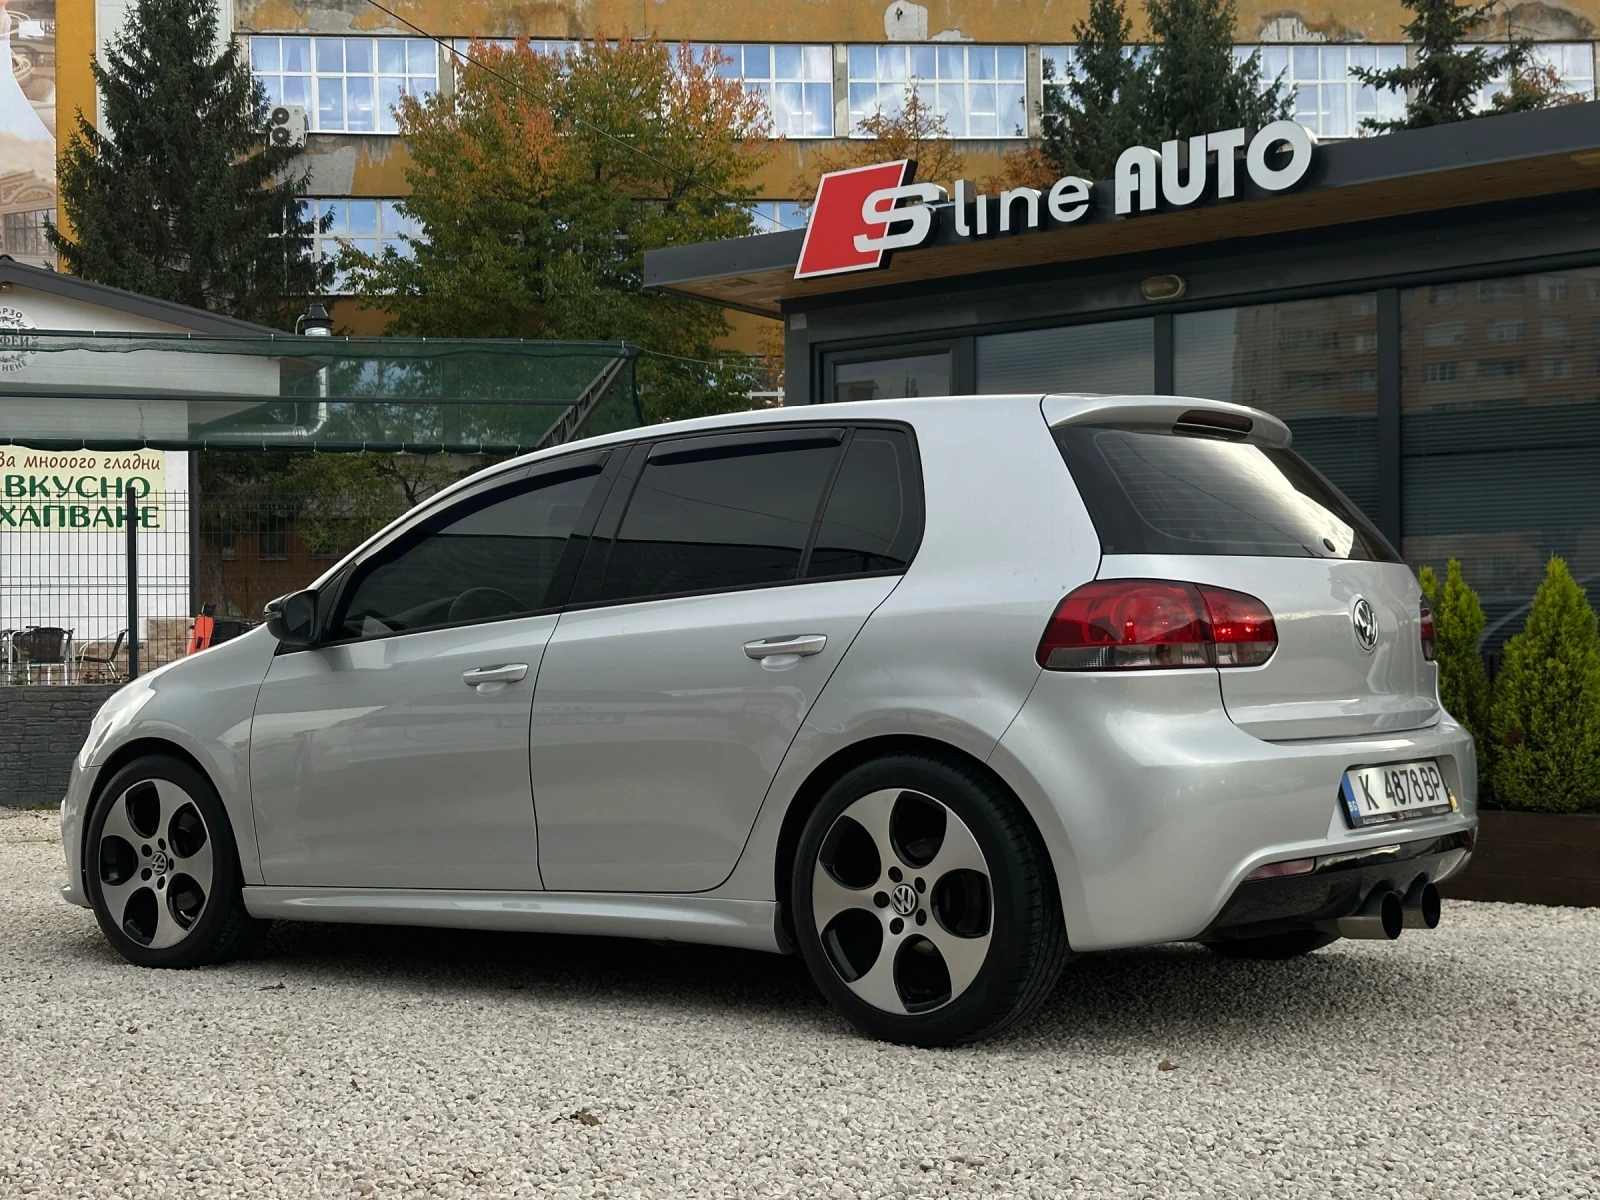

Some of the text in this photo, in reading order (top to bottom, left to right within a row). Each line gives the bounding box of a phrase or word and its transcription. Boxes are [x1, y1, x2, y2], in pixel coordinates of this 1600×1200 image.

[853, 119, 1312, 253] S line AUTO
[0, 307, 23, 319] РЗО
[23, 455, 97, 469] мнооого
[103, 453, 161, 470] гладни
[5, 475, 151, 498] ВКУСНО
[0, 505, 161, 528] ХАПВАНЕ
[1358, 774, 1380, 811] K
